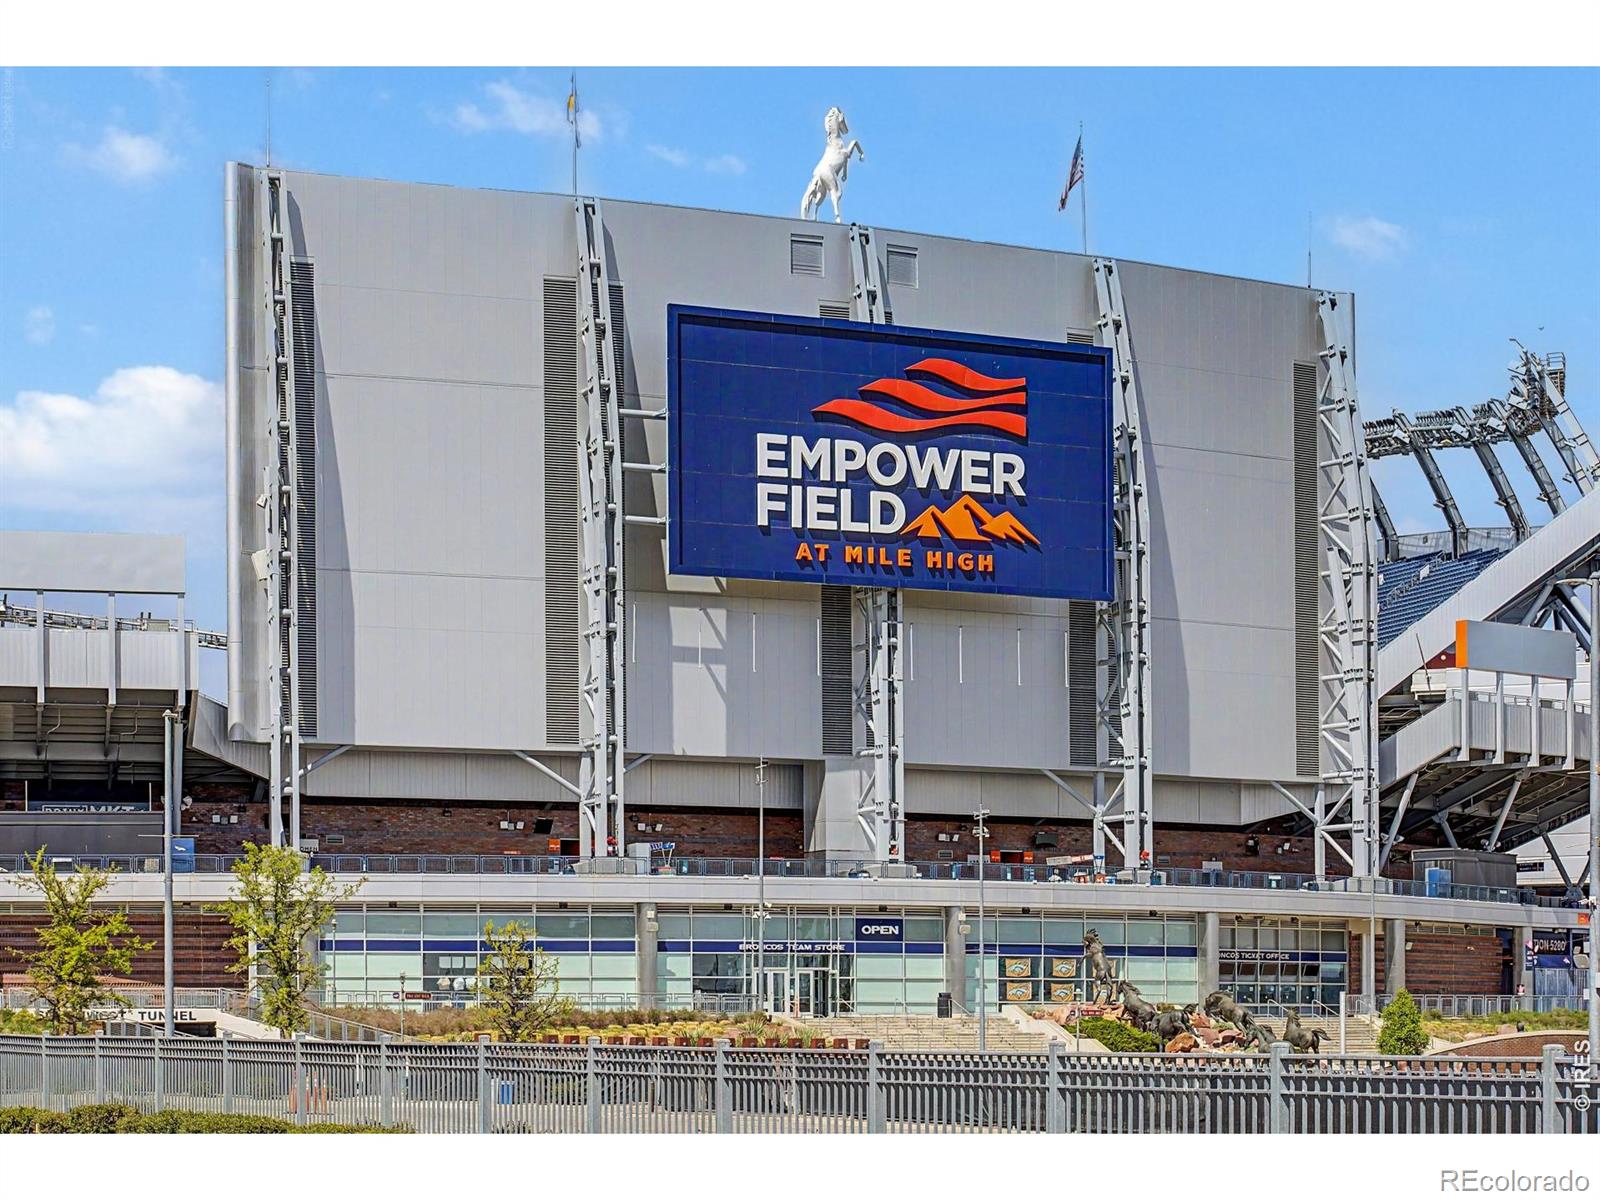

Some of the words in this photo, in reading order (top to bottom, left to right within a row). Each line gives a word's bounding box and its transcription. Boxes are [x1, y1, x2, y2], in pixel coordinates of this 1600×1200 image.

[756, 432, 1026, 497] EMPOWER
[756, 482, 907, 535] FIELD
[795, 542, 830, 562] AT
[845, 545, 912, 568] MILE
[927, 550, 995, 573] HIGH
[861, 925, 900, 935] OPEN
[786, 943, 813, 951] TEAM
[1219, 951, 1240, 959] NCOS
